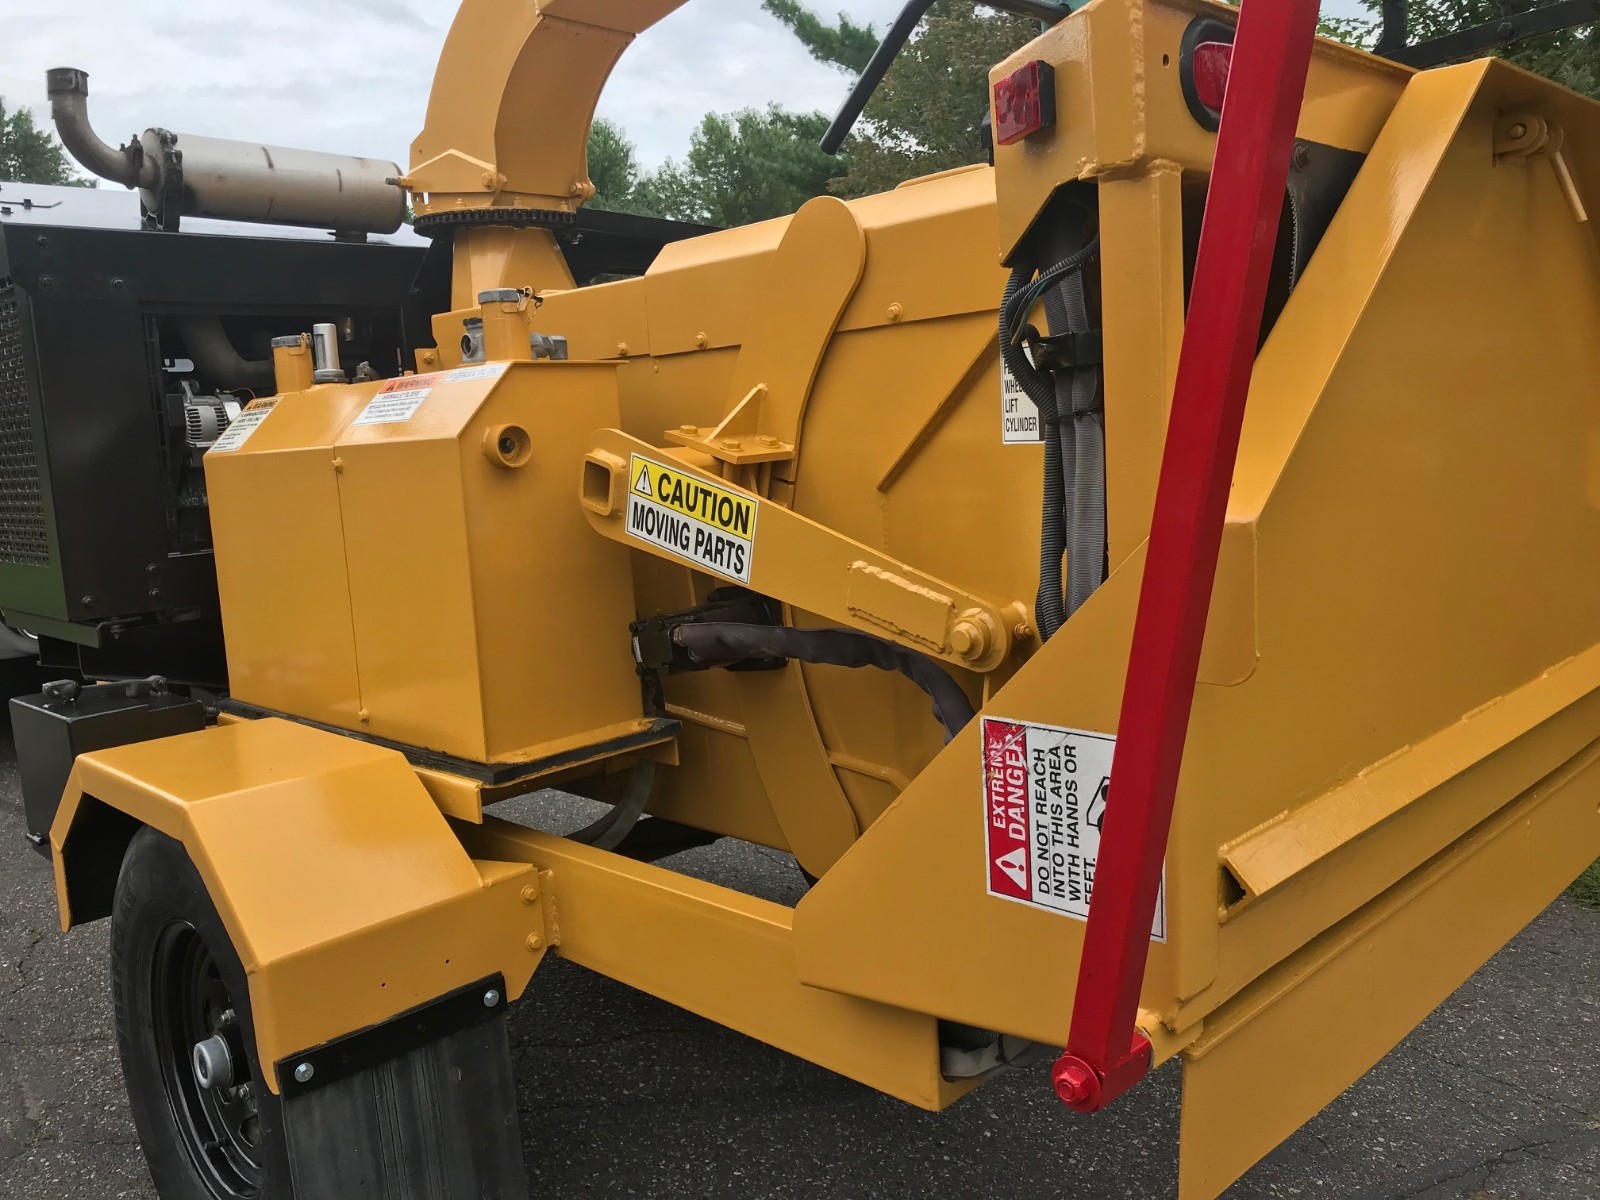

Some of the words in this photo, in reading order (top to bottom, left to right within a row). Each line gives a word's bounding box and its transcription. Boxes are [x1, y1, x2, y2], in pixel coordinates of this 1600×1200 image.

[396, 377, 437, 390] WARNING
[1005, 398, 1018, 413] LIFT
[1005, 417, 1037, 432] CYLINDER
[658, 473, 750, 535] CAUTION
[632, 501, 691, 552] MOVING
[694, 527, 745, 575] PARTS
[989, 736, 1006, 829] EXTREME
[1033, 748, 1047, 815] REACH
[1048, 745, 1062, 799] AREA
[1064, 744, 1077, 774] OR
[1050, 803, 1063, 847] THIS
[1064, 779, 1079, 849] HANDS
[1035, 820, 1049, 861] NOT
[1038, 866, 1050, 895] DO
[1051, 852, 1066, 899] INTO
[1068, 853, 1081, 902] WITH
